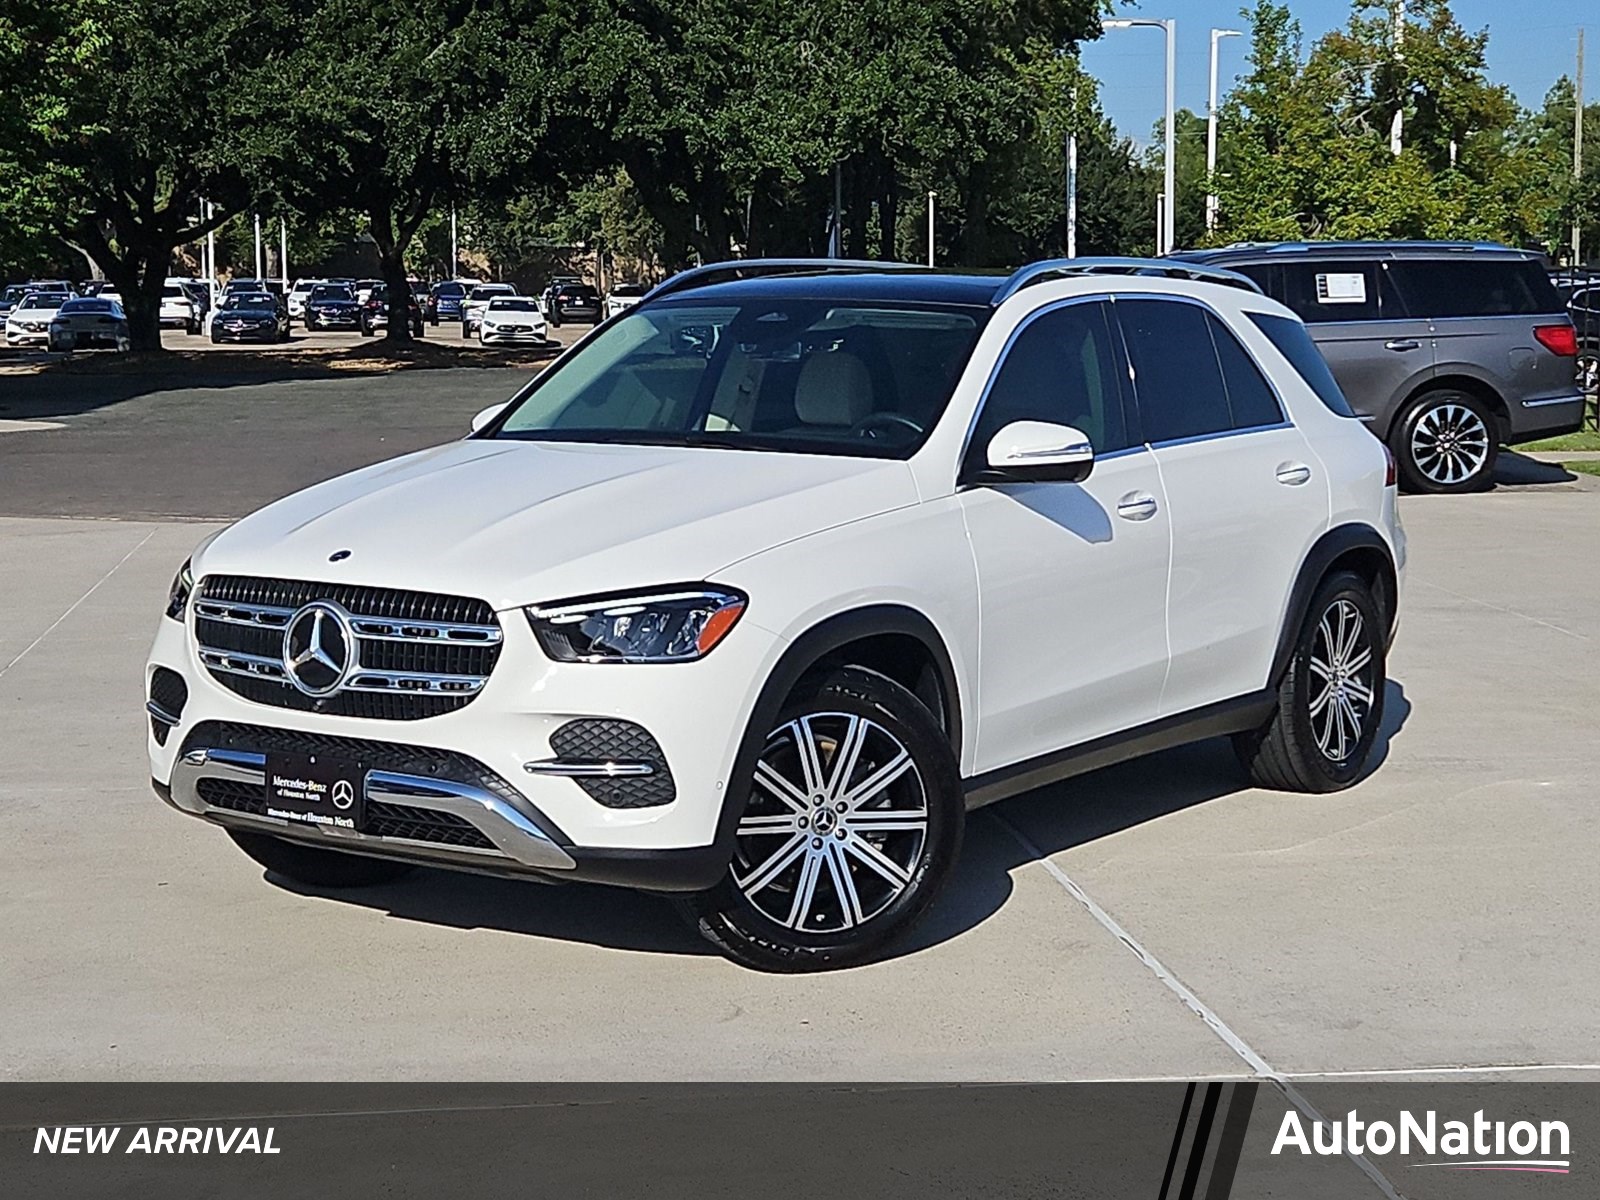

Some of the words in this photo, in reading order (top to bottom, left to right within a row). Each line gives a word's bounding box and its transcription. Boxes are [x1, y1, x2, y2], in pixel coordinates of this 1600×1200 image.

[273, 775, 327, 792] Mercedes-Benz
[307, 812, 333, 825] Houston
[334, 817, 354, 828] North
